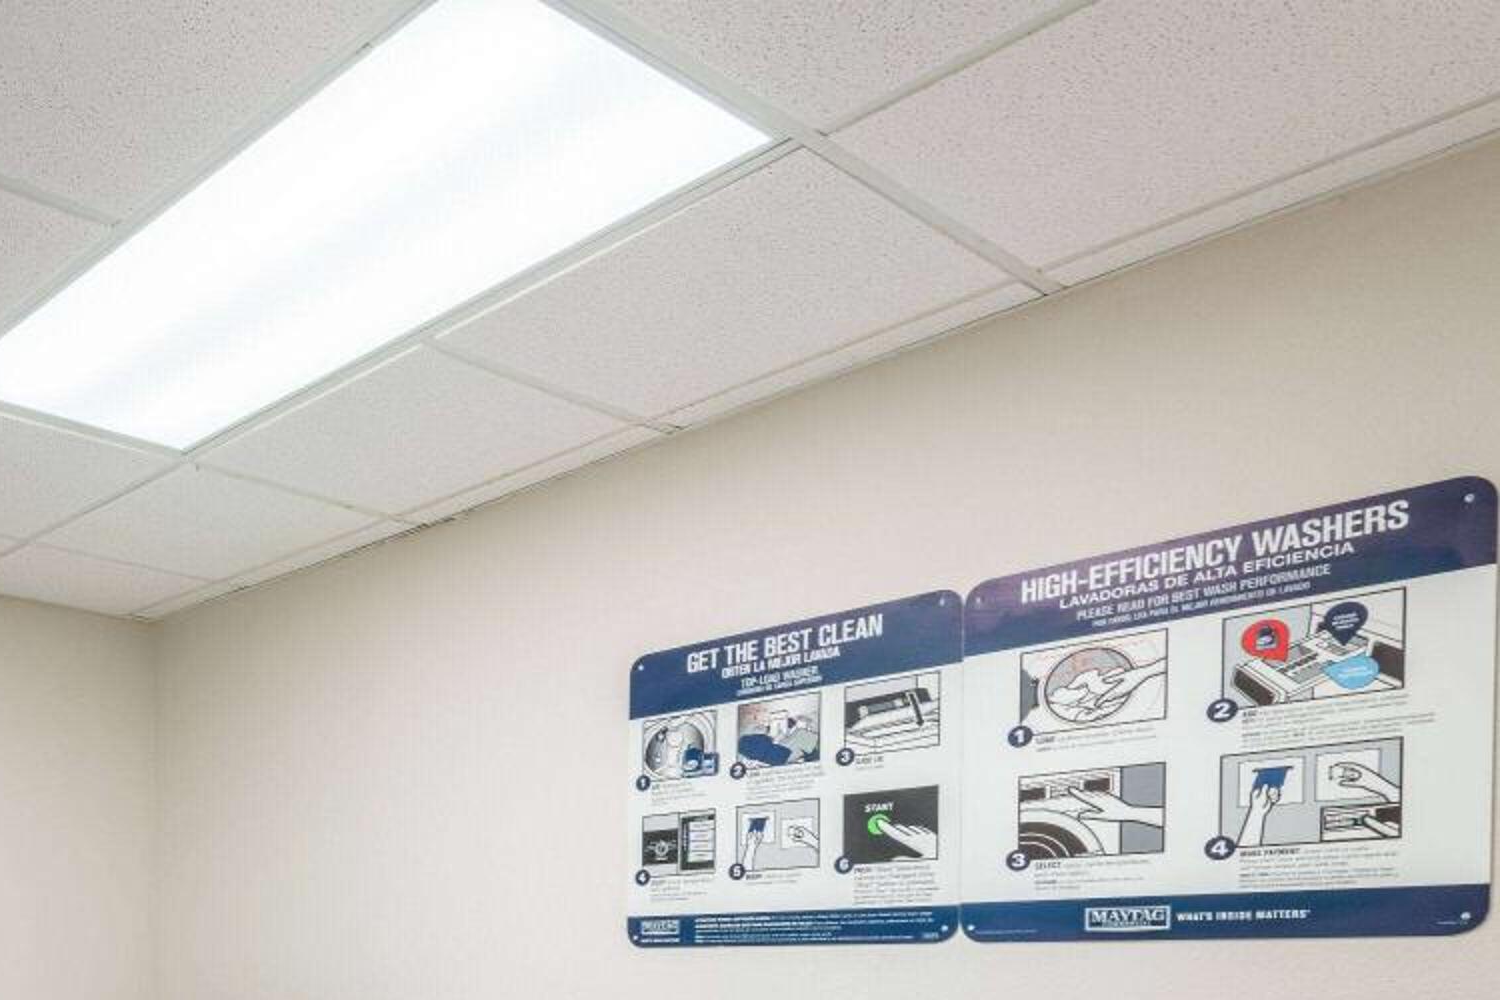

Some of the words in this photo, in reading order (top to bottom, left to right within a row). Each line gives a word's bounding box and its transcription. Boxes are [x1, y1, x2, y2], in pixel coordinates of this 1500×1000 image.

[1021, 535, 1242, 604] HIGH-EFFICIENCY
[1252, 500, 1409, 557] WASHERS
[1059, 579, 1158, 608] LAVADORAS
[1164, 574, 1188, 589] DE
[1193, 565, 1237, 583] ALTA
[1243, 541, 1355, 573] EFICIENCIA
[1076, 606, 1114, 620] PLEASE
[1117, 599, 1144, 612] READ
[1148, 595, 1169, 608] FOR
[1171, 589, 1199, 602] BEST
[1203, 582, 1237, 597] WASH
[1240, 564, 1331, 590] PERFORMANCE
[687, 648, 720, 673] GET
[724, 639, 759, 665] THE
[764, 628, 812, 658] BEST
[818, 614, 883, 647] CLEAN
[753, 661, 765, 673] LA
[864, 802, 894, 813] START
[1090, 909, 1165, 923] MAYTAG
